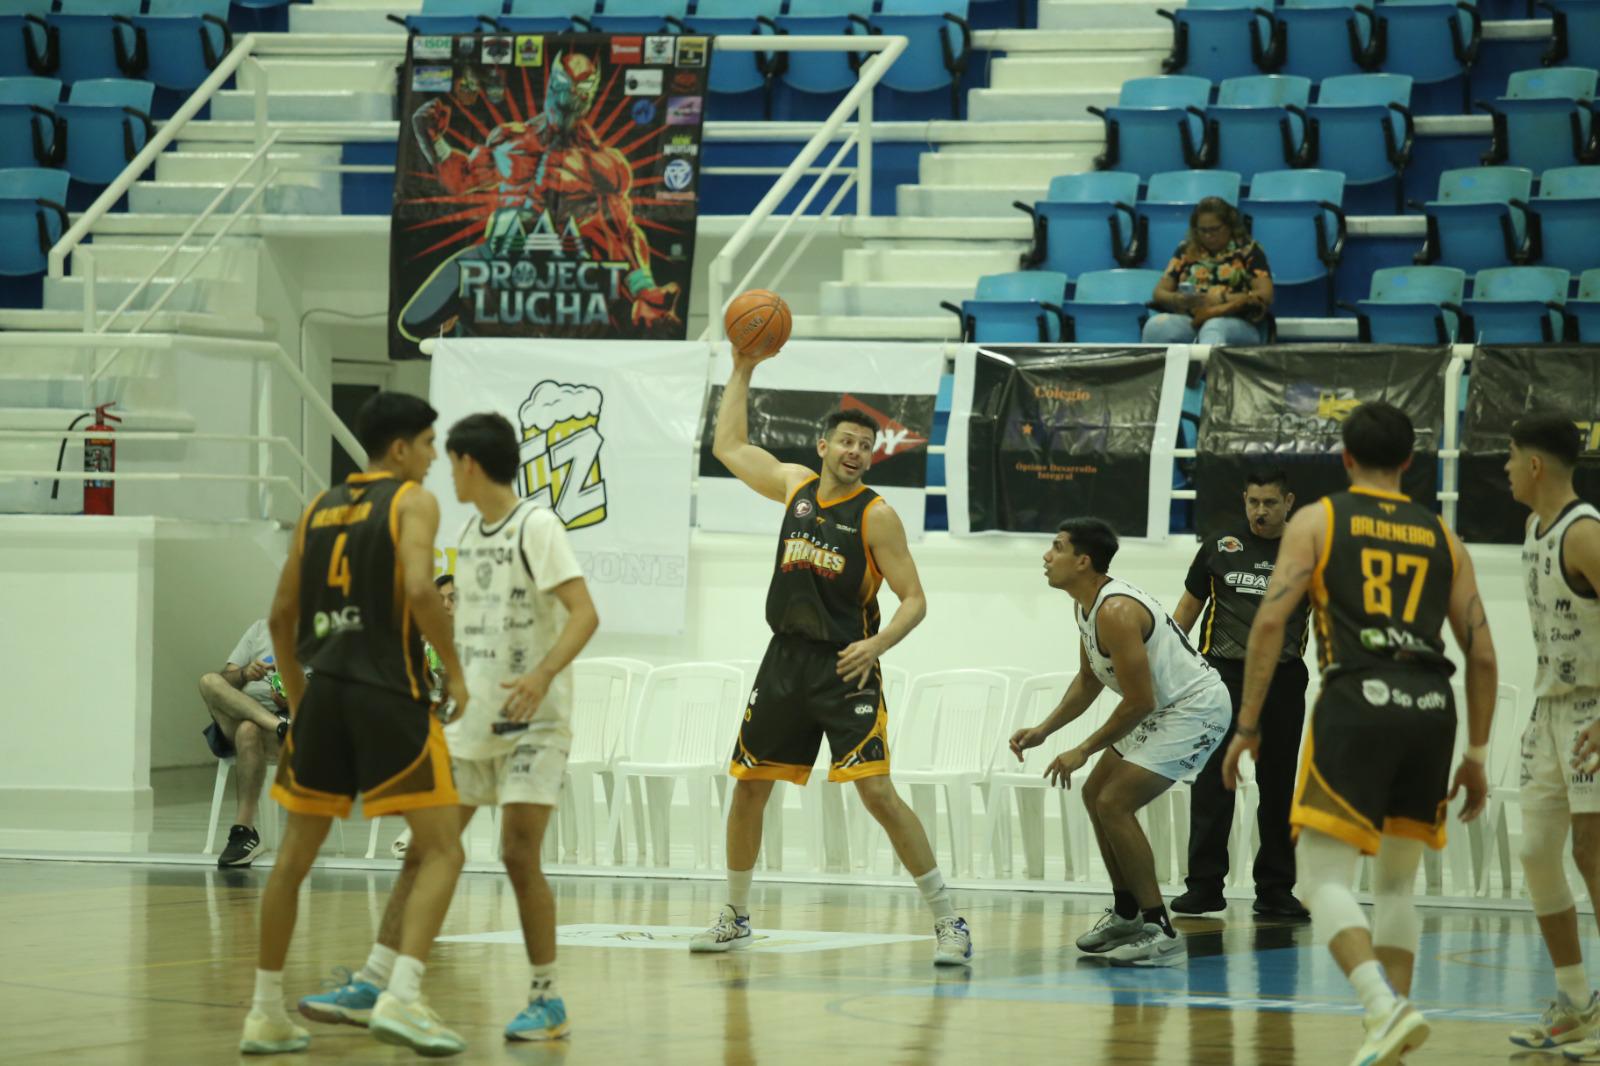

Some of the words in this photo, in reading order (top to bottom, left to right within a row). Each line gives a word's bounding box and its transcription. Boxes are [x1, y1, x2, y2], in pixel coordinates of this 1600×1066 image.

[458, 260, 630, 299] PROJECT
[474, 289, 610, 325] LUCHA
[1034, 386, 1091, 403] Colegio
[327, 532, 352, 598] 4
[495, 548, 514, 565] 34
[1544, 557, 1552, 576] 9
[1225, 573, 1272, 589] CIBA
[1361, 548, 1429, 623] 87
